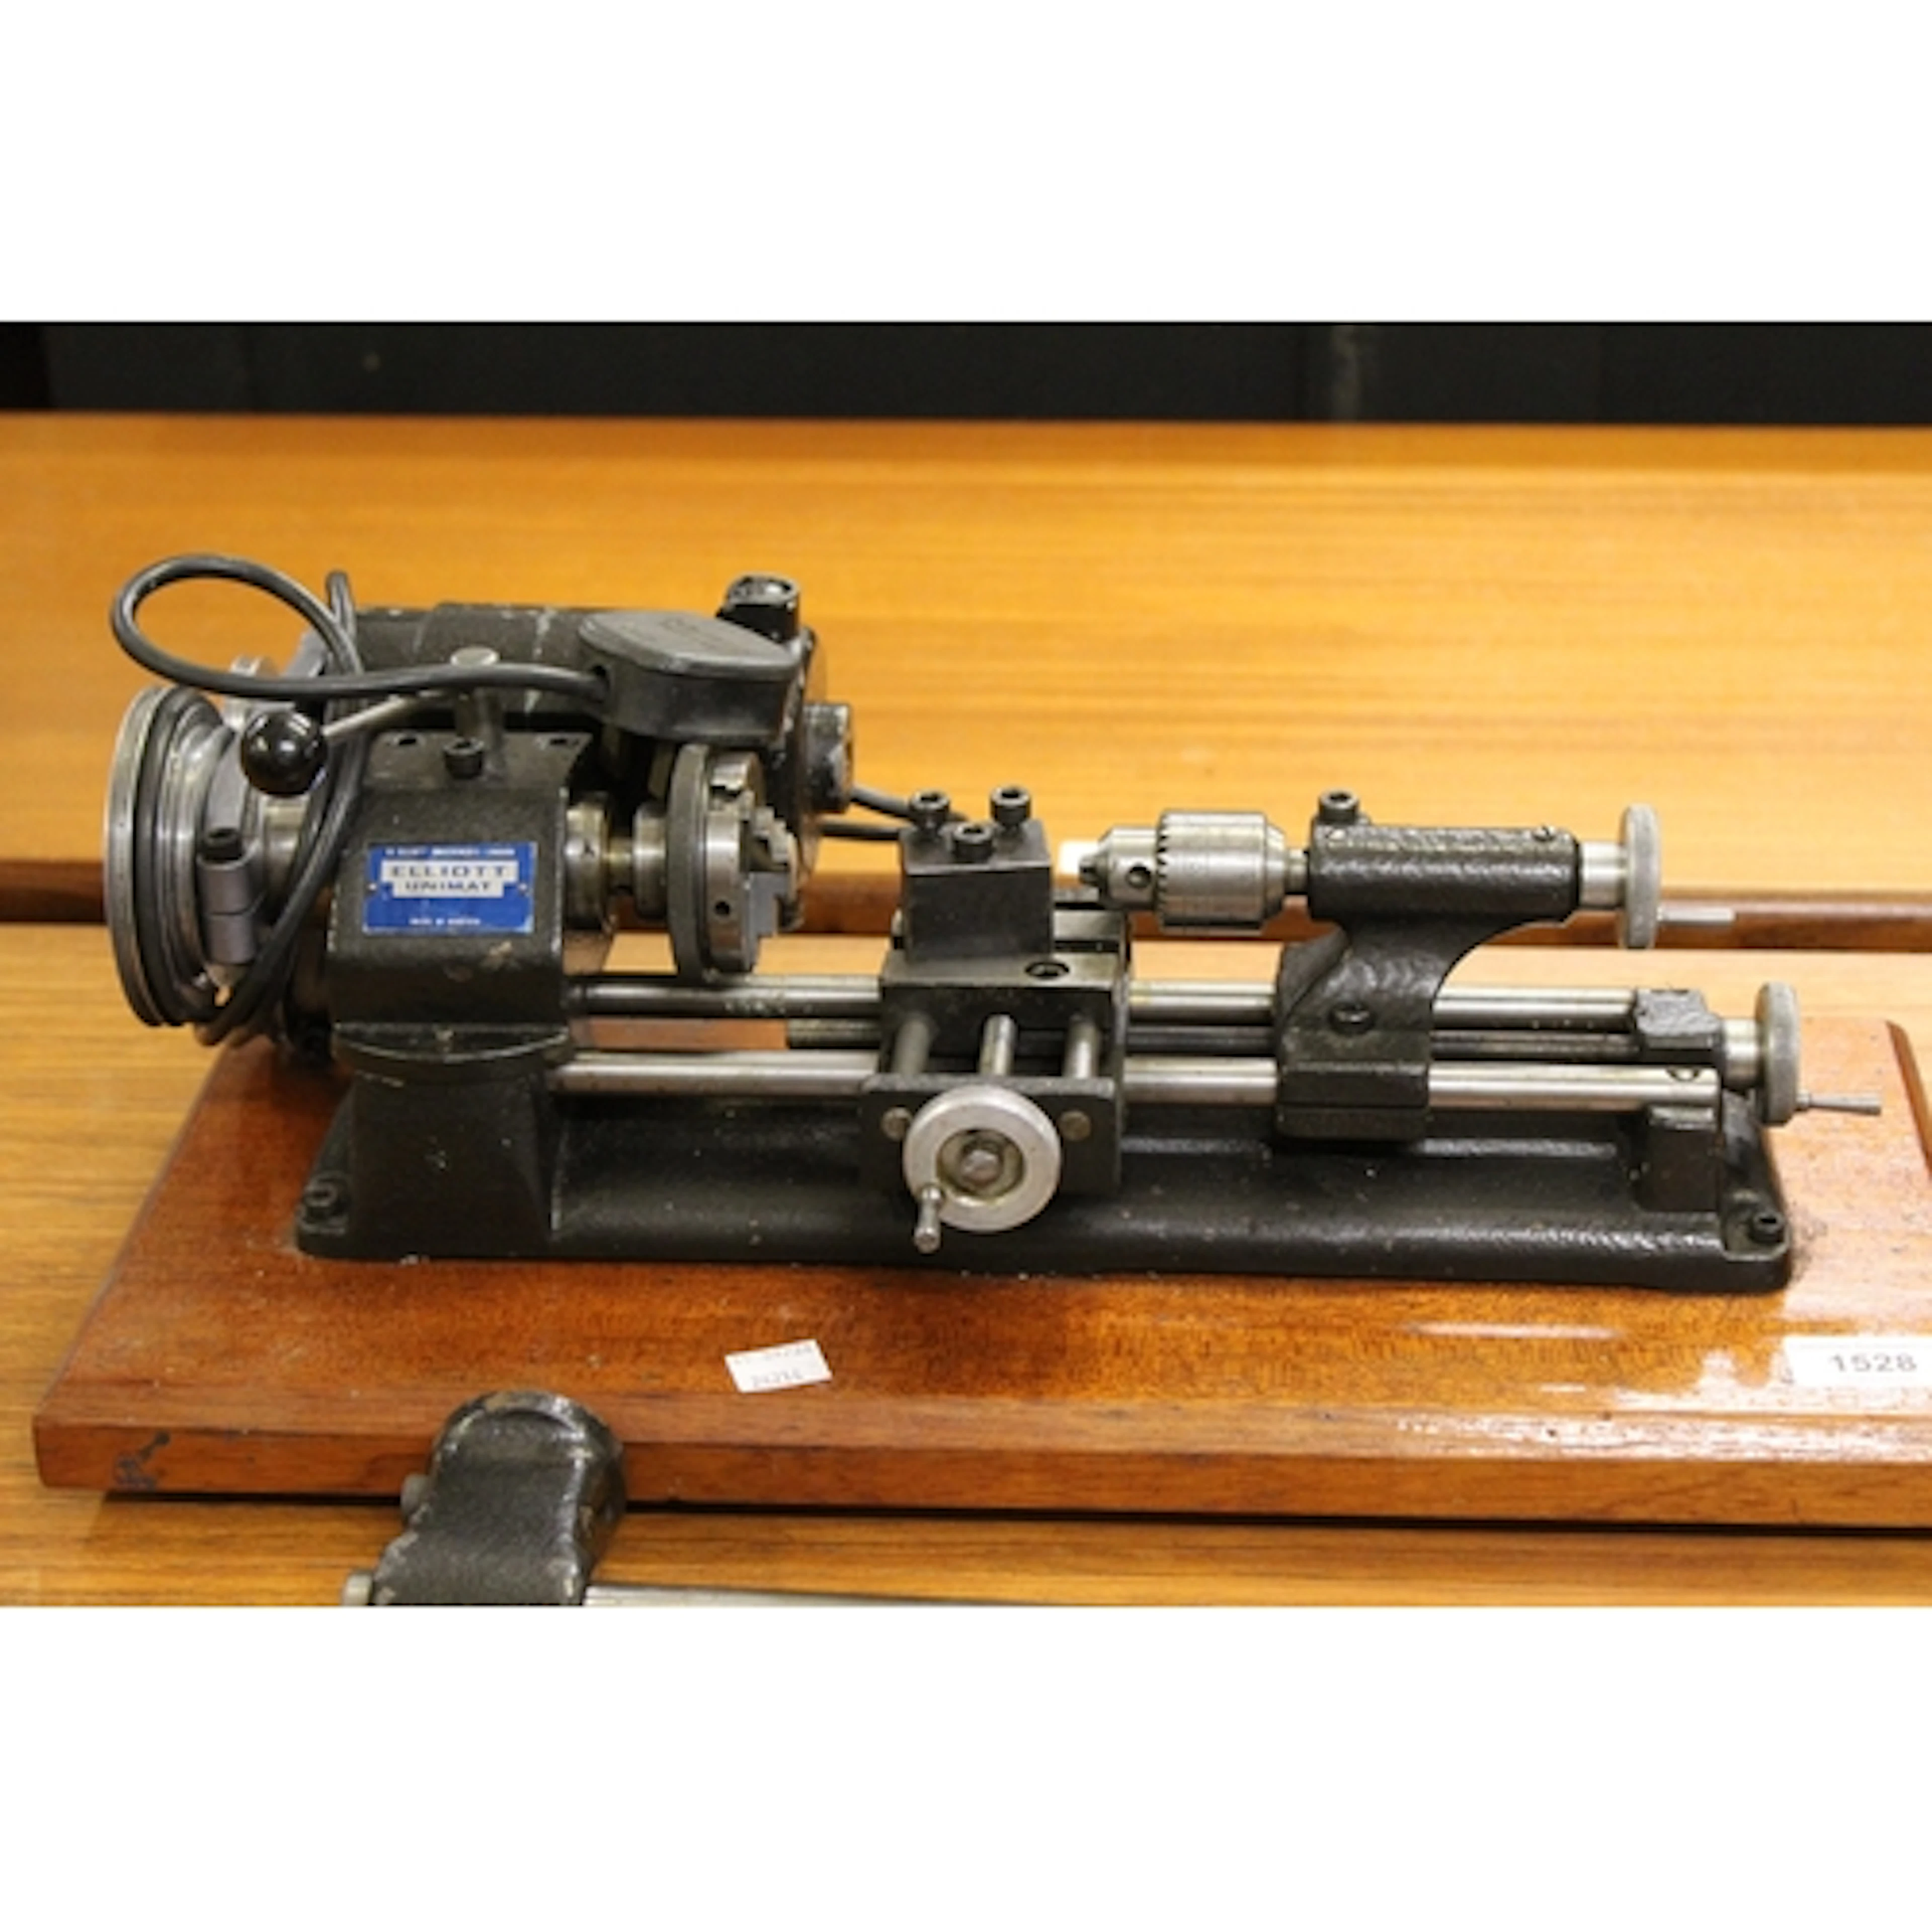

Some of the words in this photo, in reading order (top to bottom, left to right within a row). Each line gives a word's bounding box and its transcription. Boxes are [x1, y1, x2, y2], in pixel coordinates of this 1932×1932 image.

[391, 865, 506, 878] ELLIOTT
[405, 881, 491, 892] UNIMAT
[1830, 1352, 1917, 1373] 1528
